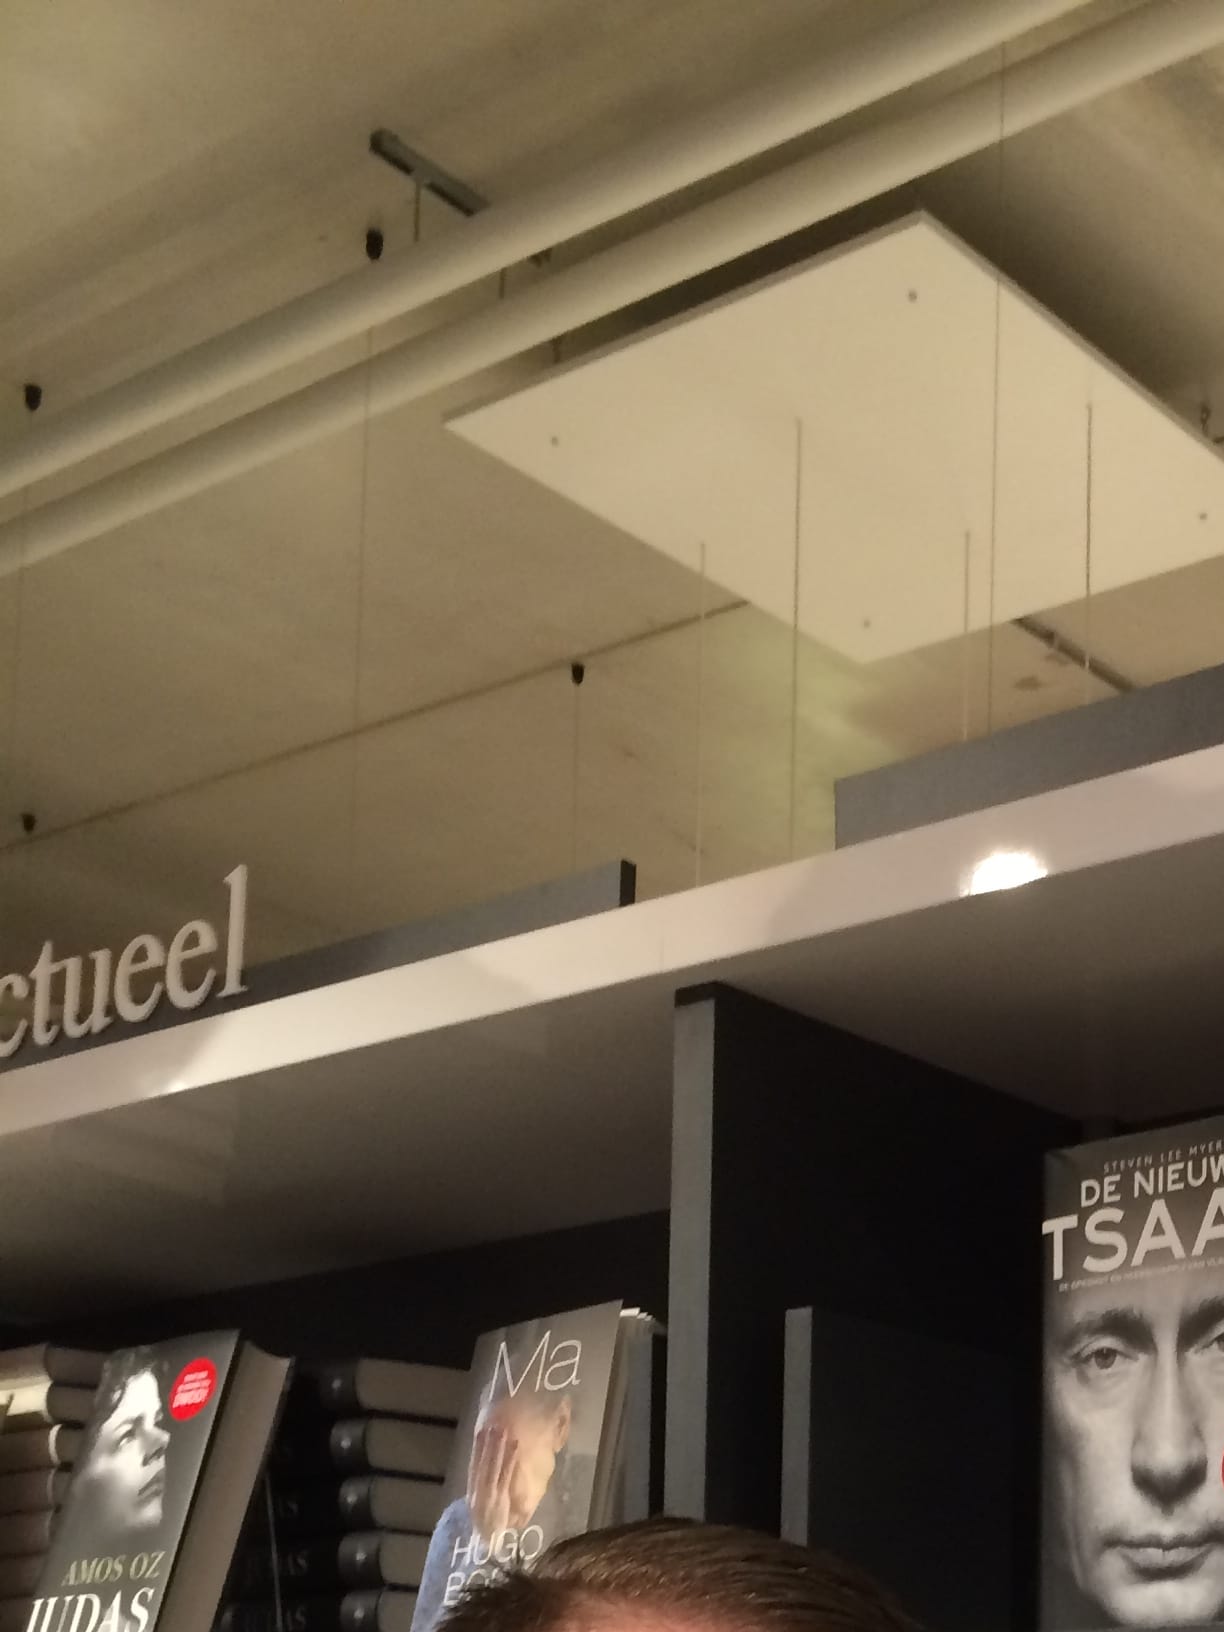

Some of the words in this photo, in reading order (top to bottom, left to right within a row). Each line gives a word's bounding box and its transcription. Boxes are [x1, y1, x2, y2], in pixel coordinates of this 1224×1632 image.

[1103, 1154, 1153, 1175] STEVEN
[1080, 1174, 1122, 1209] DE
[488, 1328, 582, 1402] Ma
[450, 1524, 544, 1569] HUGO
[61, 1555, 124, 1587] AMOS
[128, 1550, 167, 1581] OZ
